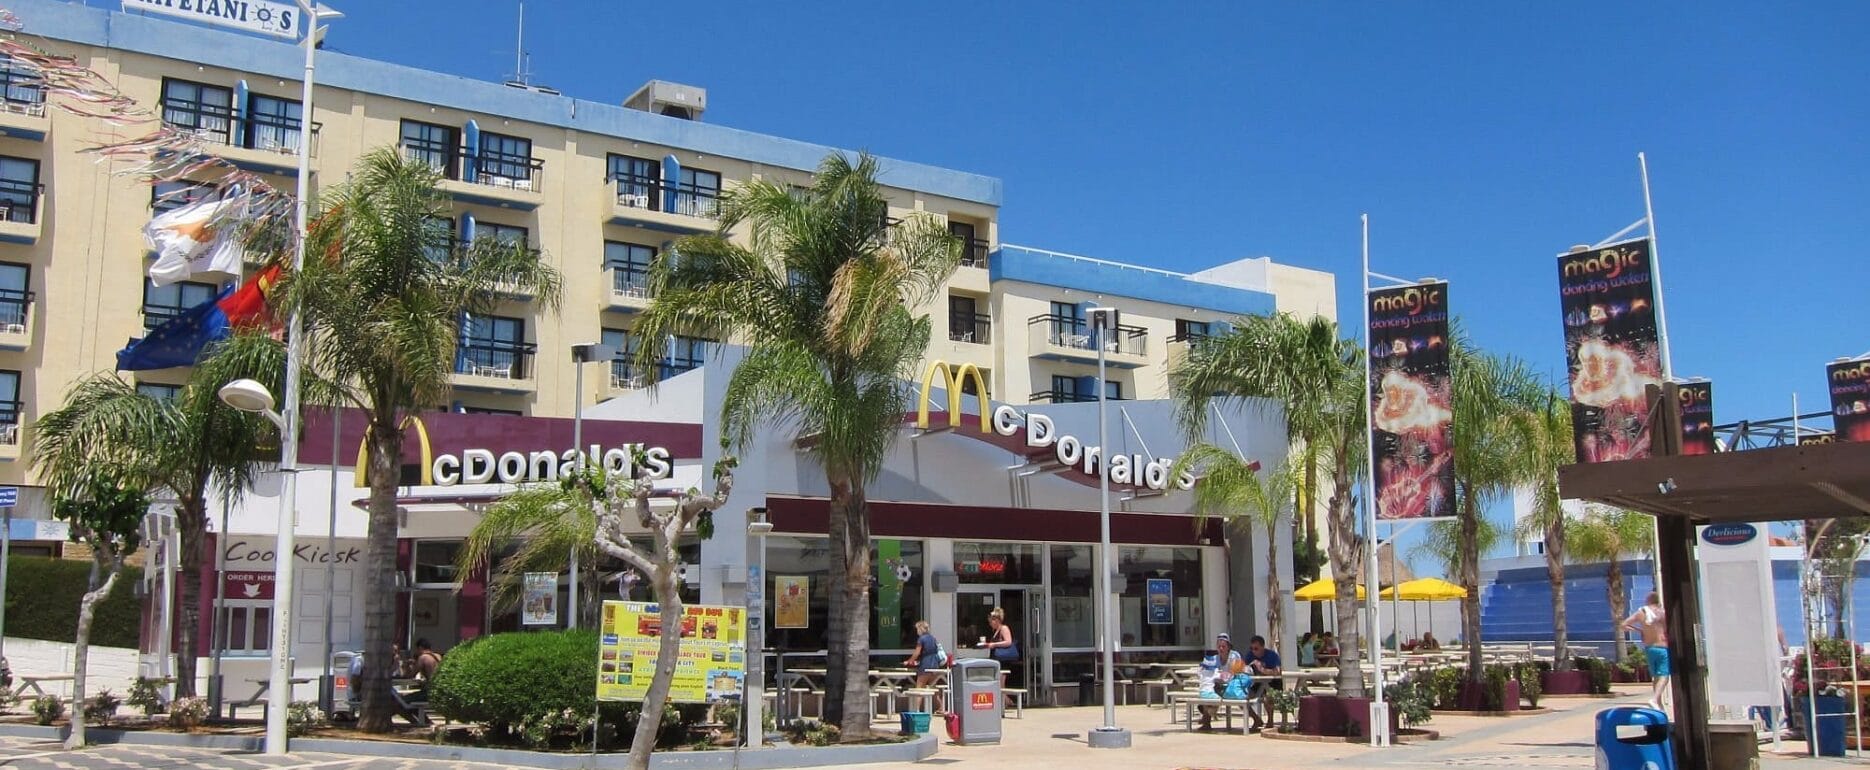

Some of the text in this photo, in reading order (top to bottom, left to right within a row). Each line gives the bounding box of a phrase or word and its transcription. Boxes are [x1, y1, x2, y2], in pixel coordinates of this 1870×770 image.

[1564, 247, 1640, 278] magic
[1373, 288, 1439, 315] magic
[225, 541, 278, 563] Coo
[227, 573, 255, 581] ORDER
